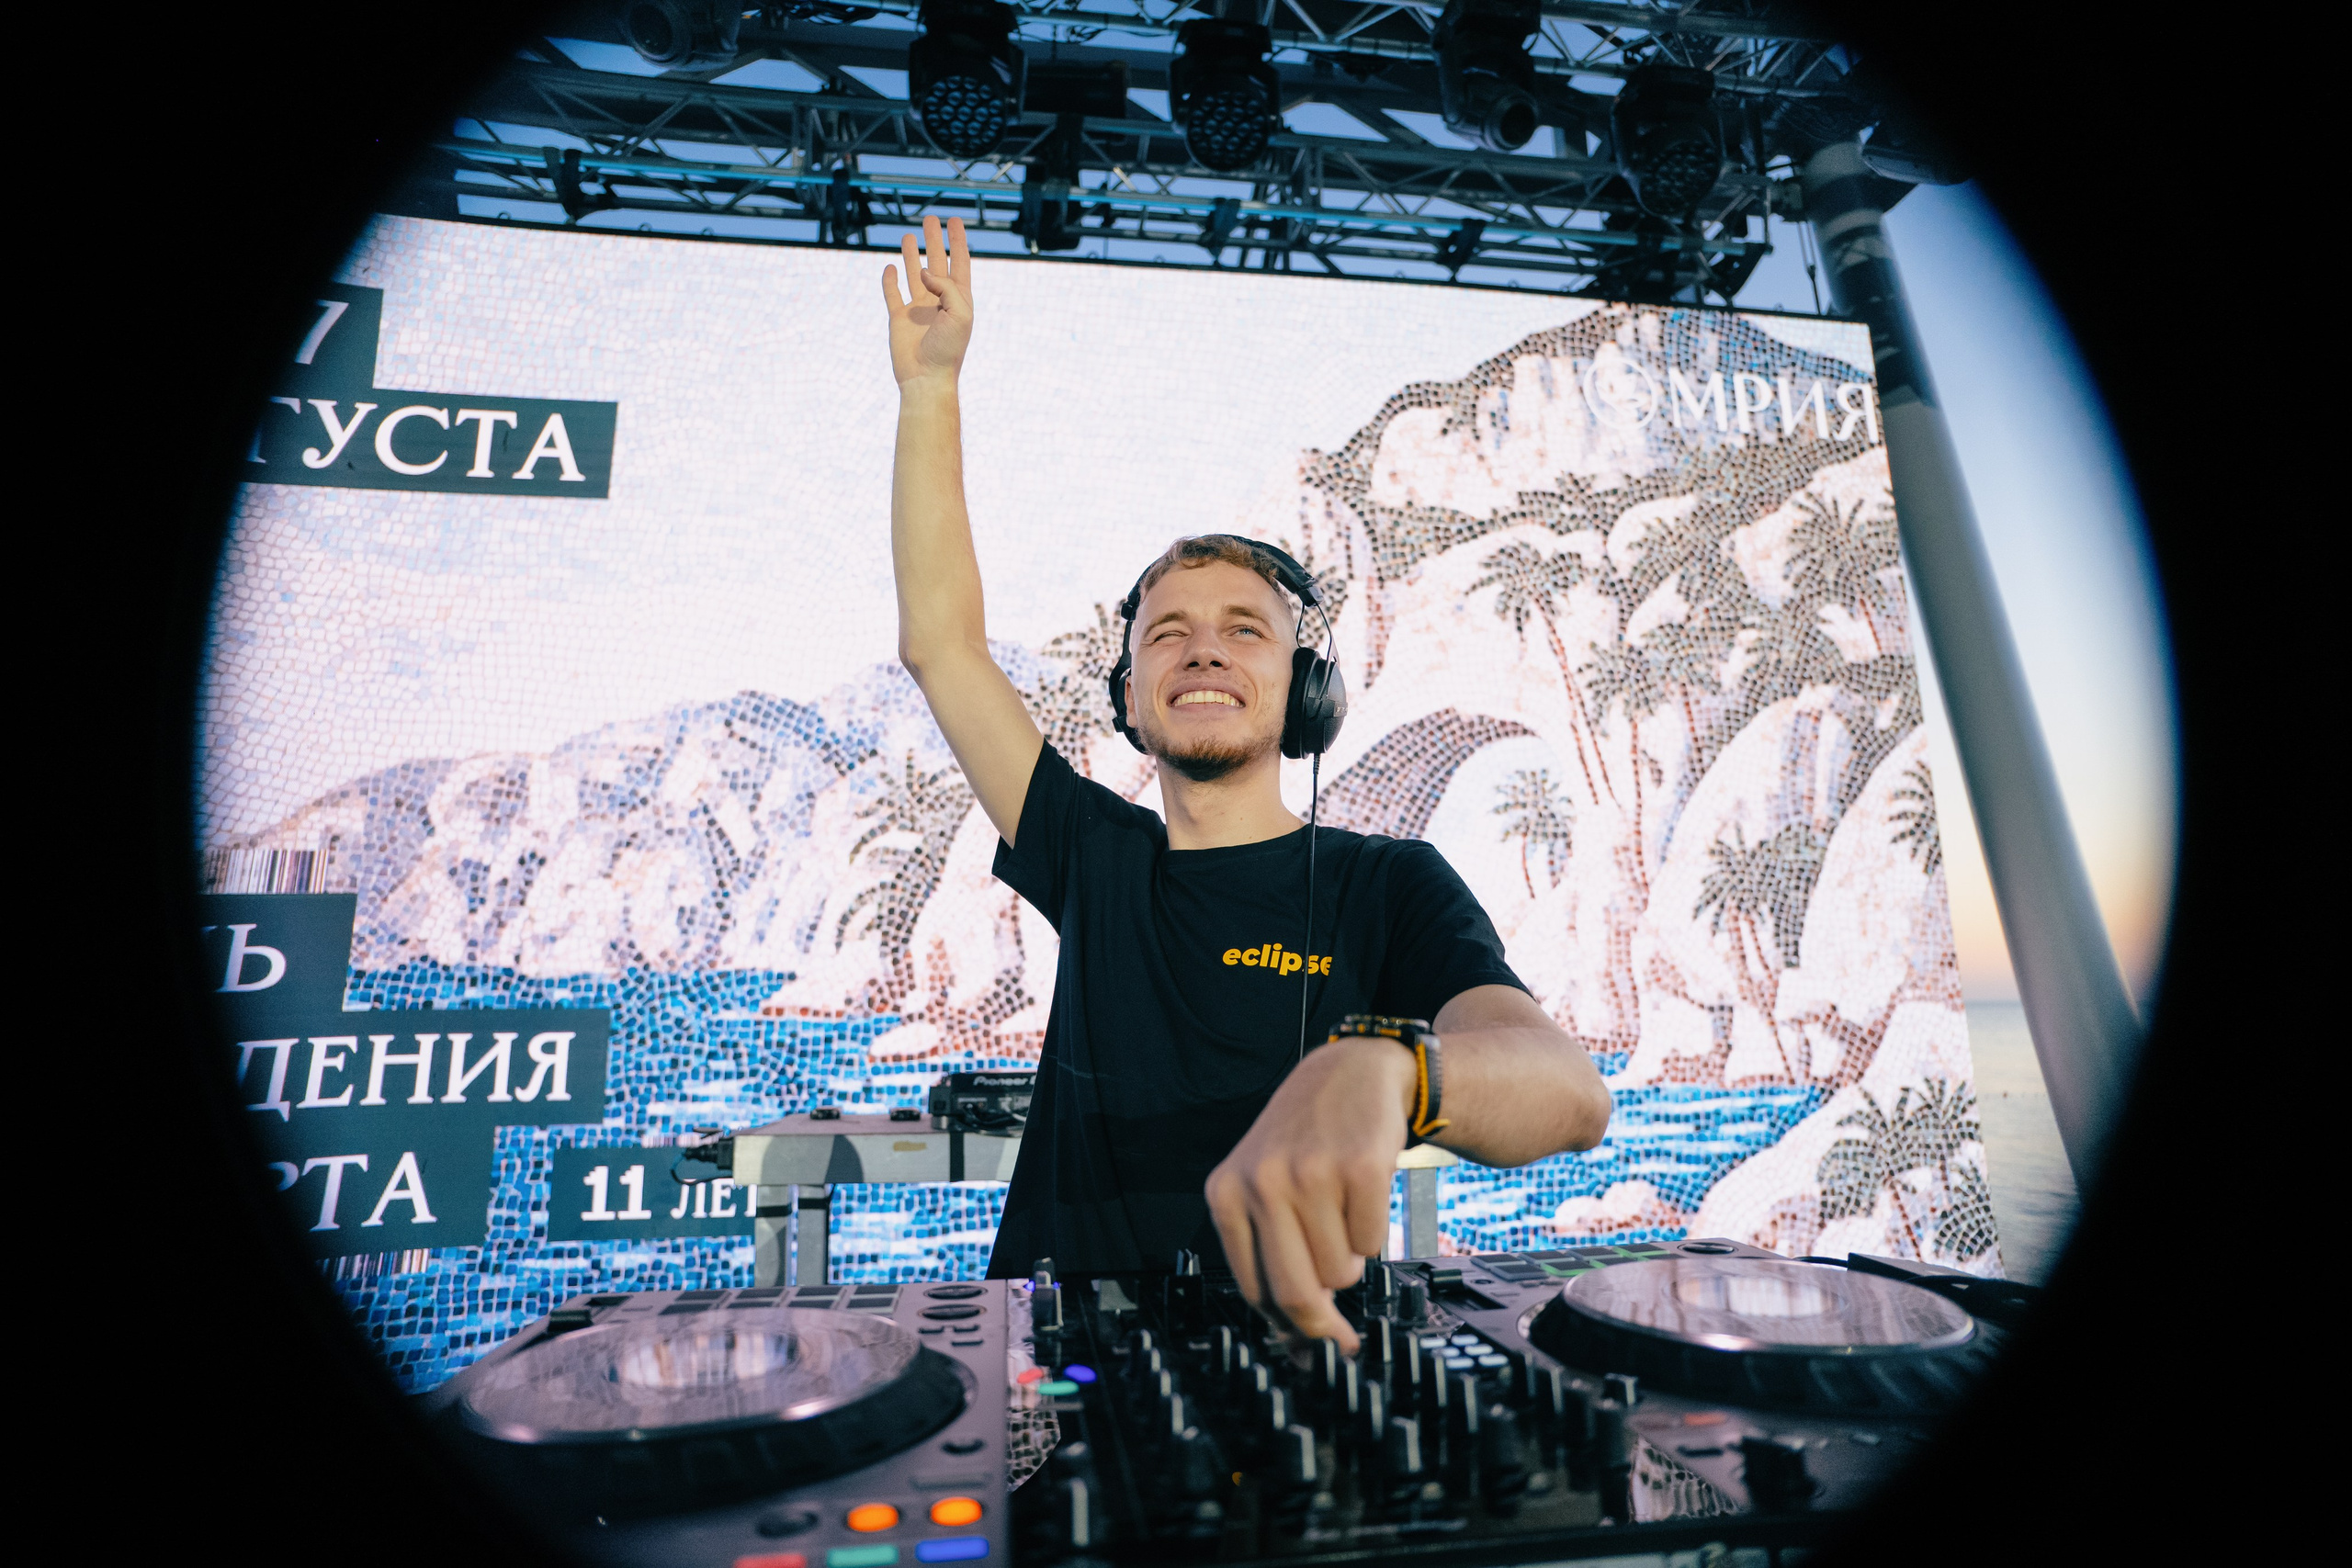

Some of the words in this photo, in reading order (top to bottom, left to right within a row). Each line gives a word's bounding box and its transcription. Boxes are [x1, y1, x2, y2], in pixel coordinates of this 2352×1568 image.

[1668, 367, 1880, 444] МРИЯ
[1222, 942, 1333, 976] eclipse
[973, 1076, 1029, 1087] Pioneer
[580, 1164, 652, 1221] 11
